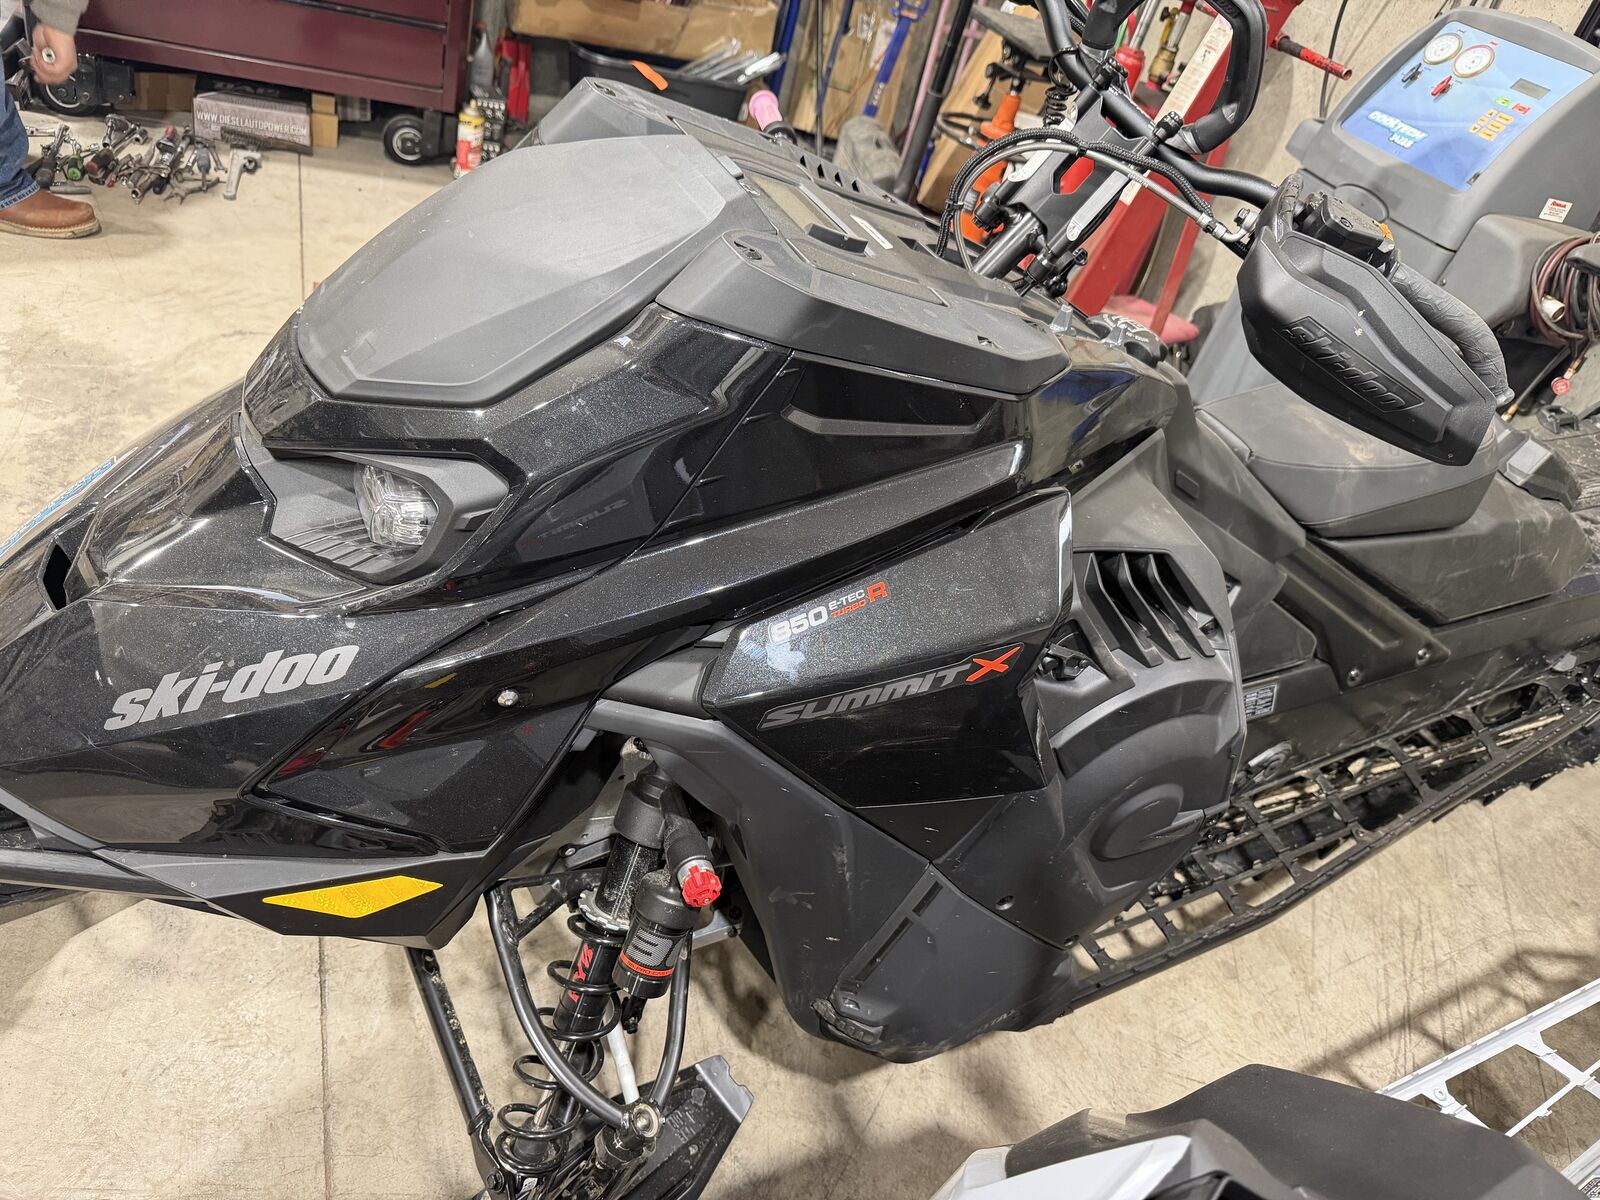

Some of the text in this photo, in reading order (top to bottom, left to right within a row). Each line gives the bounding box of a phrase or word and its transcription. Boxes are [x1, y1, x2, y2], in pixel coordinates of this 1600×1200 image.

[196, 110, 307, 136] WWW.DIESELAUTOPOWER.COM
[770, 581, 889, 643] 850 E-TEC R
[830, 599, 867, 618] TURBO
[103, 645, 359, 731] ski-doo
[761, 646, 1021, 728] SUMMIT X
